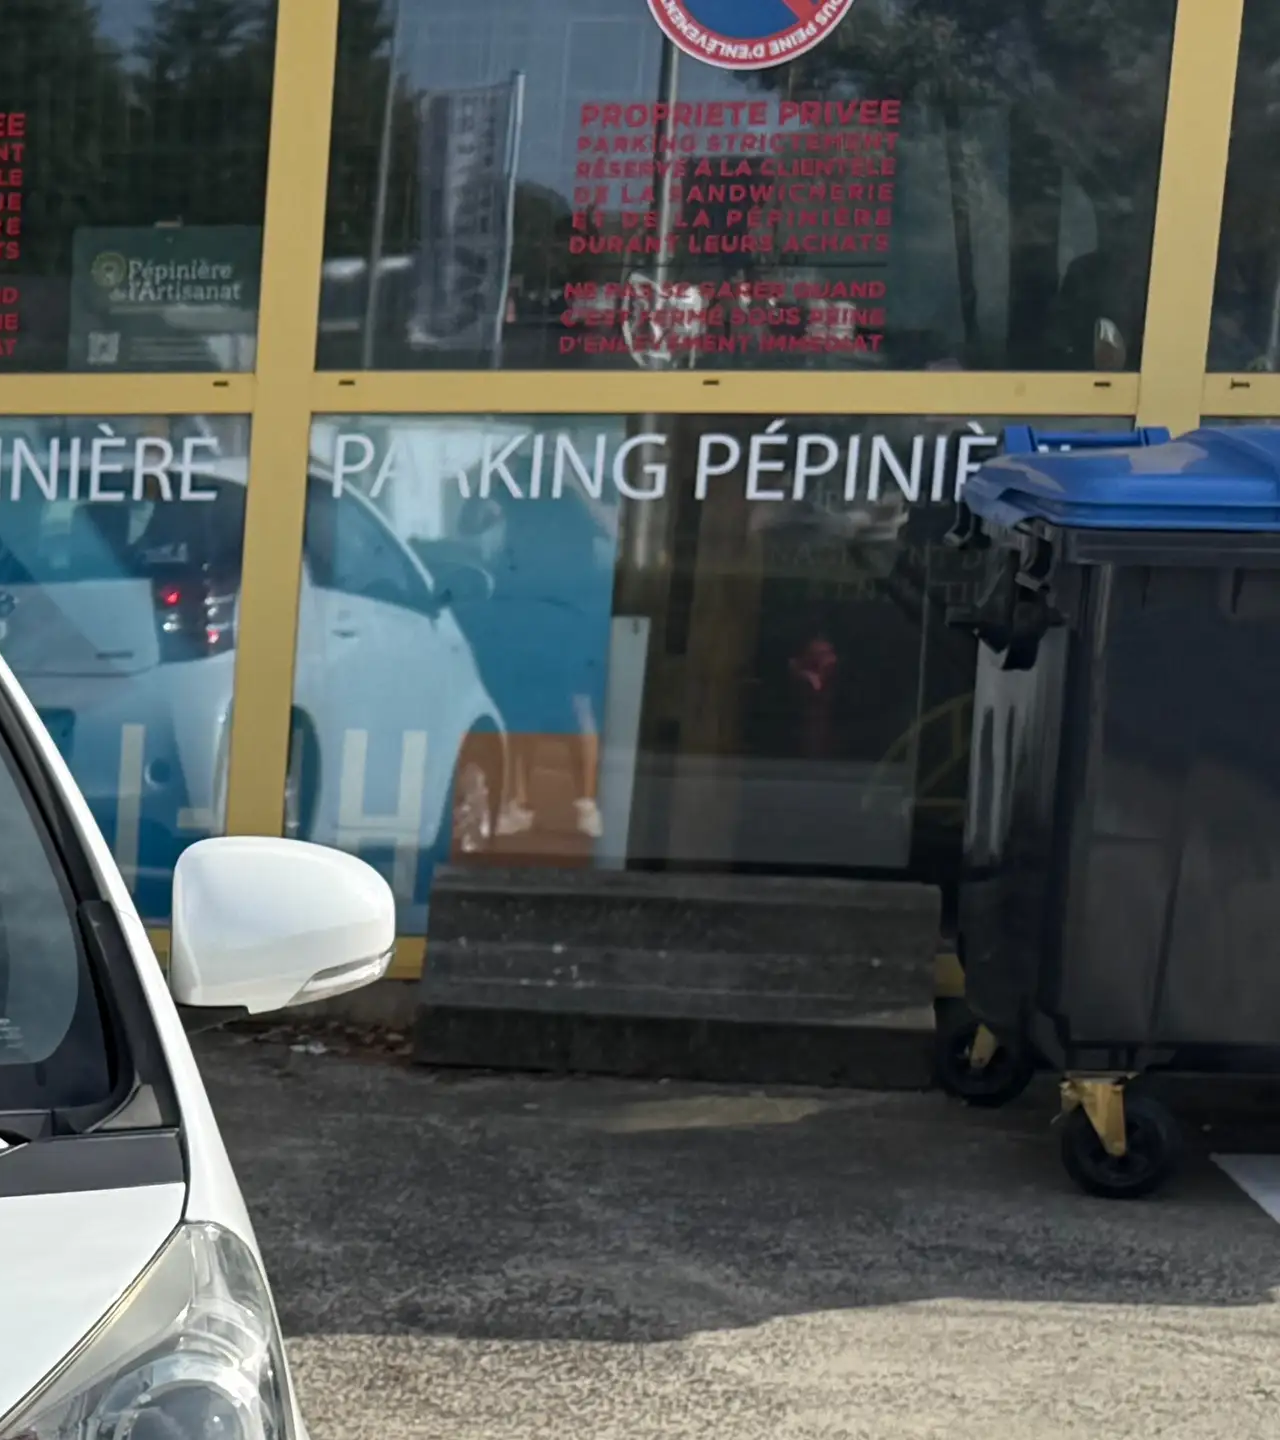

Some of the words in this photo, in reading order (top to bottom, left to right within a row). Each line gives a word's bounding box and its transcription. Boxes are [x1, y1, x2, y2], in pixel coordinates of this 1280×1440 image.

[768, 21, 817, 57] PEINE
[580, 104, 767, 128] PROPRIETE
[778, 100, 901, 125] PRIVEE
[577, 135, 696, 153] PARKING
[706, 132, 899, 152] STRICTEMENT
[576, 156, 686, 178] RÉSERVÉ
[694, 156, 712, 177] À
[720, 159, 751, 177] LA
[759, 155, 896, 176] CLIENTÈLE
[574, 185, 612, 204] DE
[621, 185, 654, 203] LA
[669, 183, 894, 202] SANDWICHERIE
[571, 211, 605, 230] ET
[622, 211, 658, 229] DE
[676, 210, 710, 228] LA
[726, 205, 892, 227] PÉPINIÈRE
[569, 236, 680, 254] DURANT
[691, 235, 773, 253] LEURS
[783, 234, 889, 252] ACHATS
[128, 258, 233, 284] Pépinière
[564, 283, 597, 299] NE
[604, 283, 649, 299] PAS
[661, 283, 693, 299] SE
[702, 282, 786, 298] GARER
[794, 281, 886, 298] QUAND
[560, 308, 630, 327] C'EST
[642, 305, 724, 326] FERMÉ
[730, 307, 801, 325] SOUS
[808, 308, 885, 325] PEINE
[559, 335, 752, 354] D'ENLEVEMENT
[759, 334, 884, 353] IMMEDIAT
